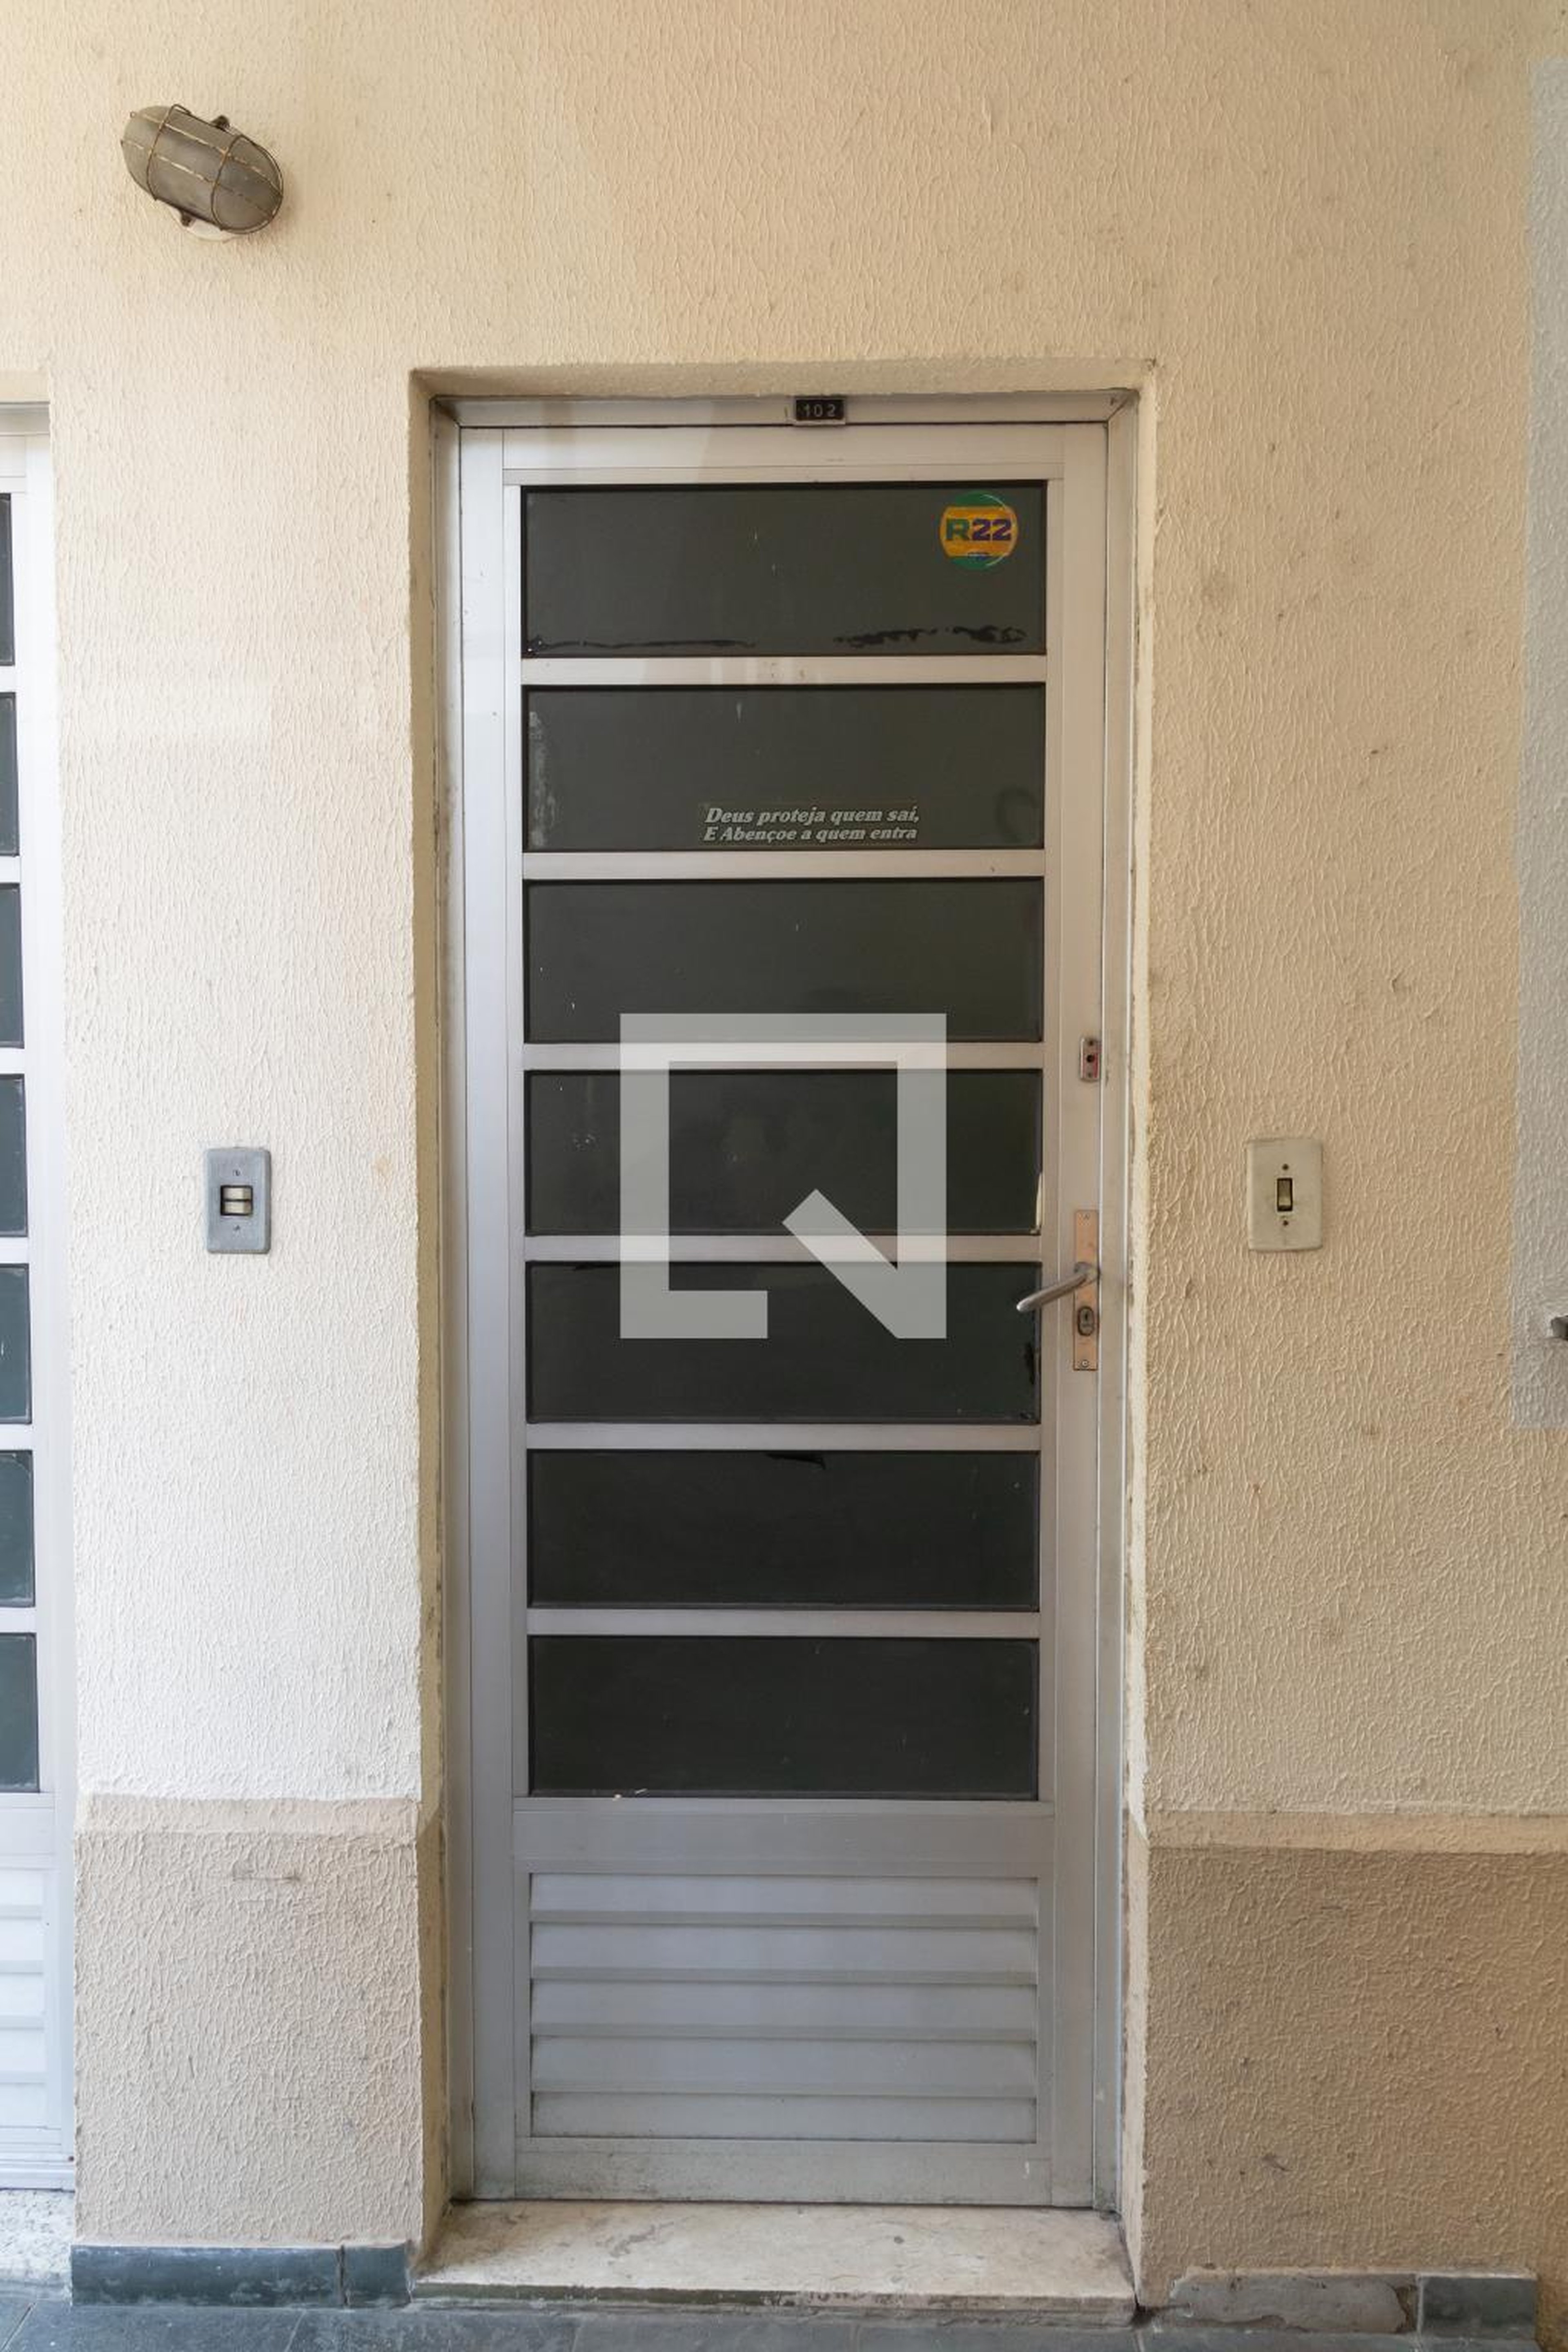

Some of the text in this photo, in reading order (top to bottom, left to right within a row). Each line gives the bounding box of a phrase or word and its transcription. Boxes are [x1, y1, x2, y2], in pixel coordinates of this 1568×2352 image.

[803, 403, 836, 417] 102
[945, 518, 1012, 541] R22
[704, 808, 755, 823] Deus
[756, 806, 826, 826] proteja
[831, 811, 883, 826] quem
[703, 826, 918, 843] E Abençoe a quem entra
